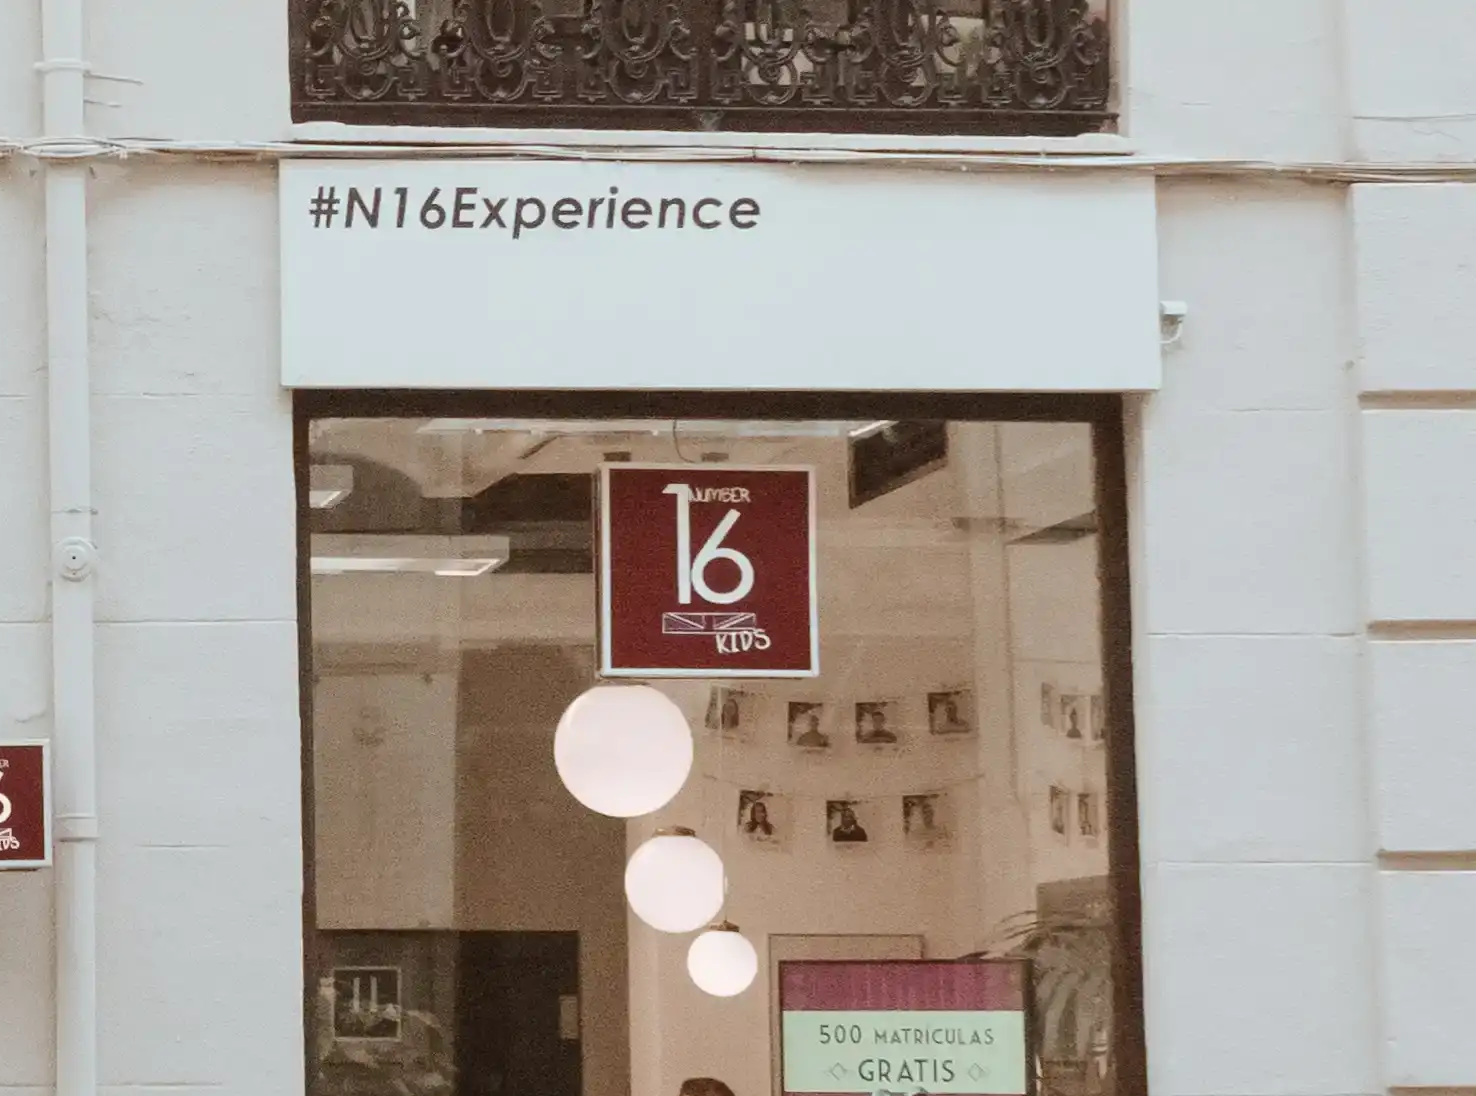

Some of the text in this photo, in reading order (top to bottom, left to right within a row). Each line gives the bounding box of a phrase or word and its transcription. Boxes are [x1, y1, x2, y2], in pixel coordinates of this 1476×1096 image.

[309, 186, 761, 239] #N16Experience
[688, 487, 751, 503] NUMBER
[662, 484, 755, 604] 16
[715, 628, 771, 653] KIDS
[819, 1024, 862, 1044] 500
[858, 1058, 955, 1082] GRATIS
